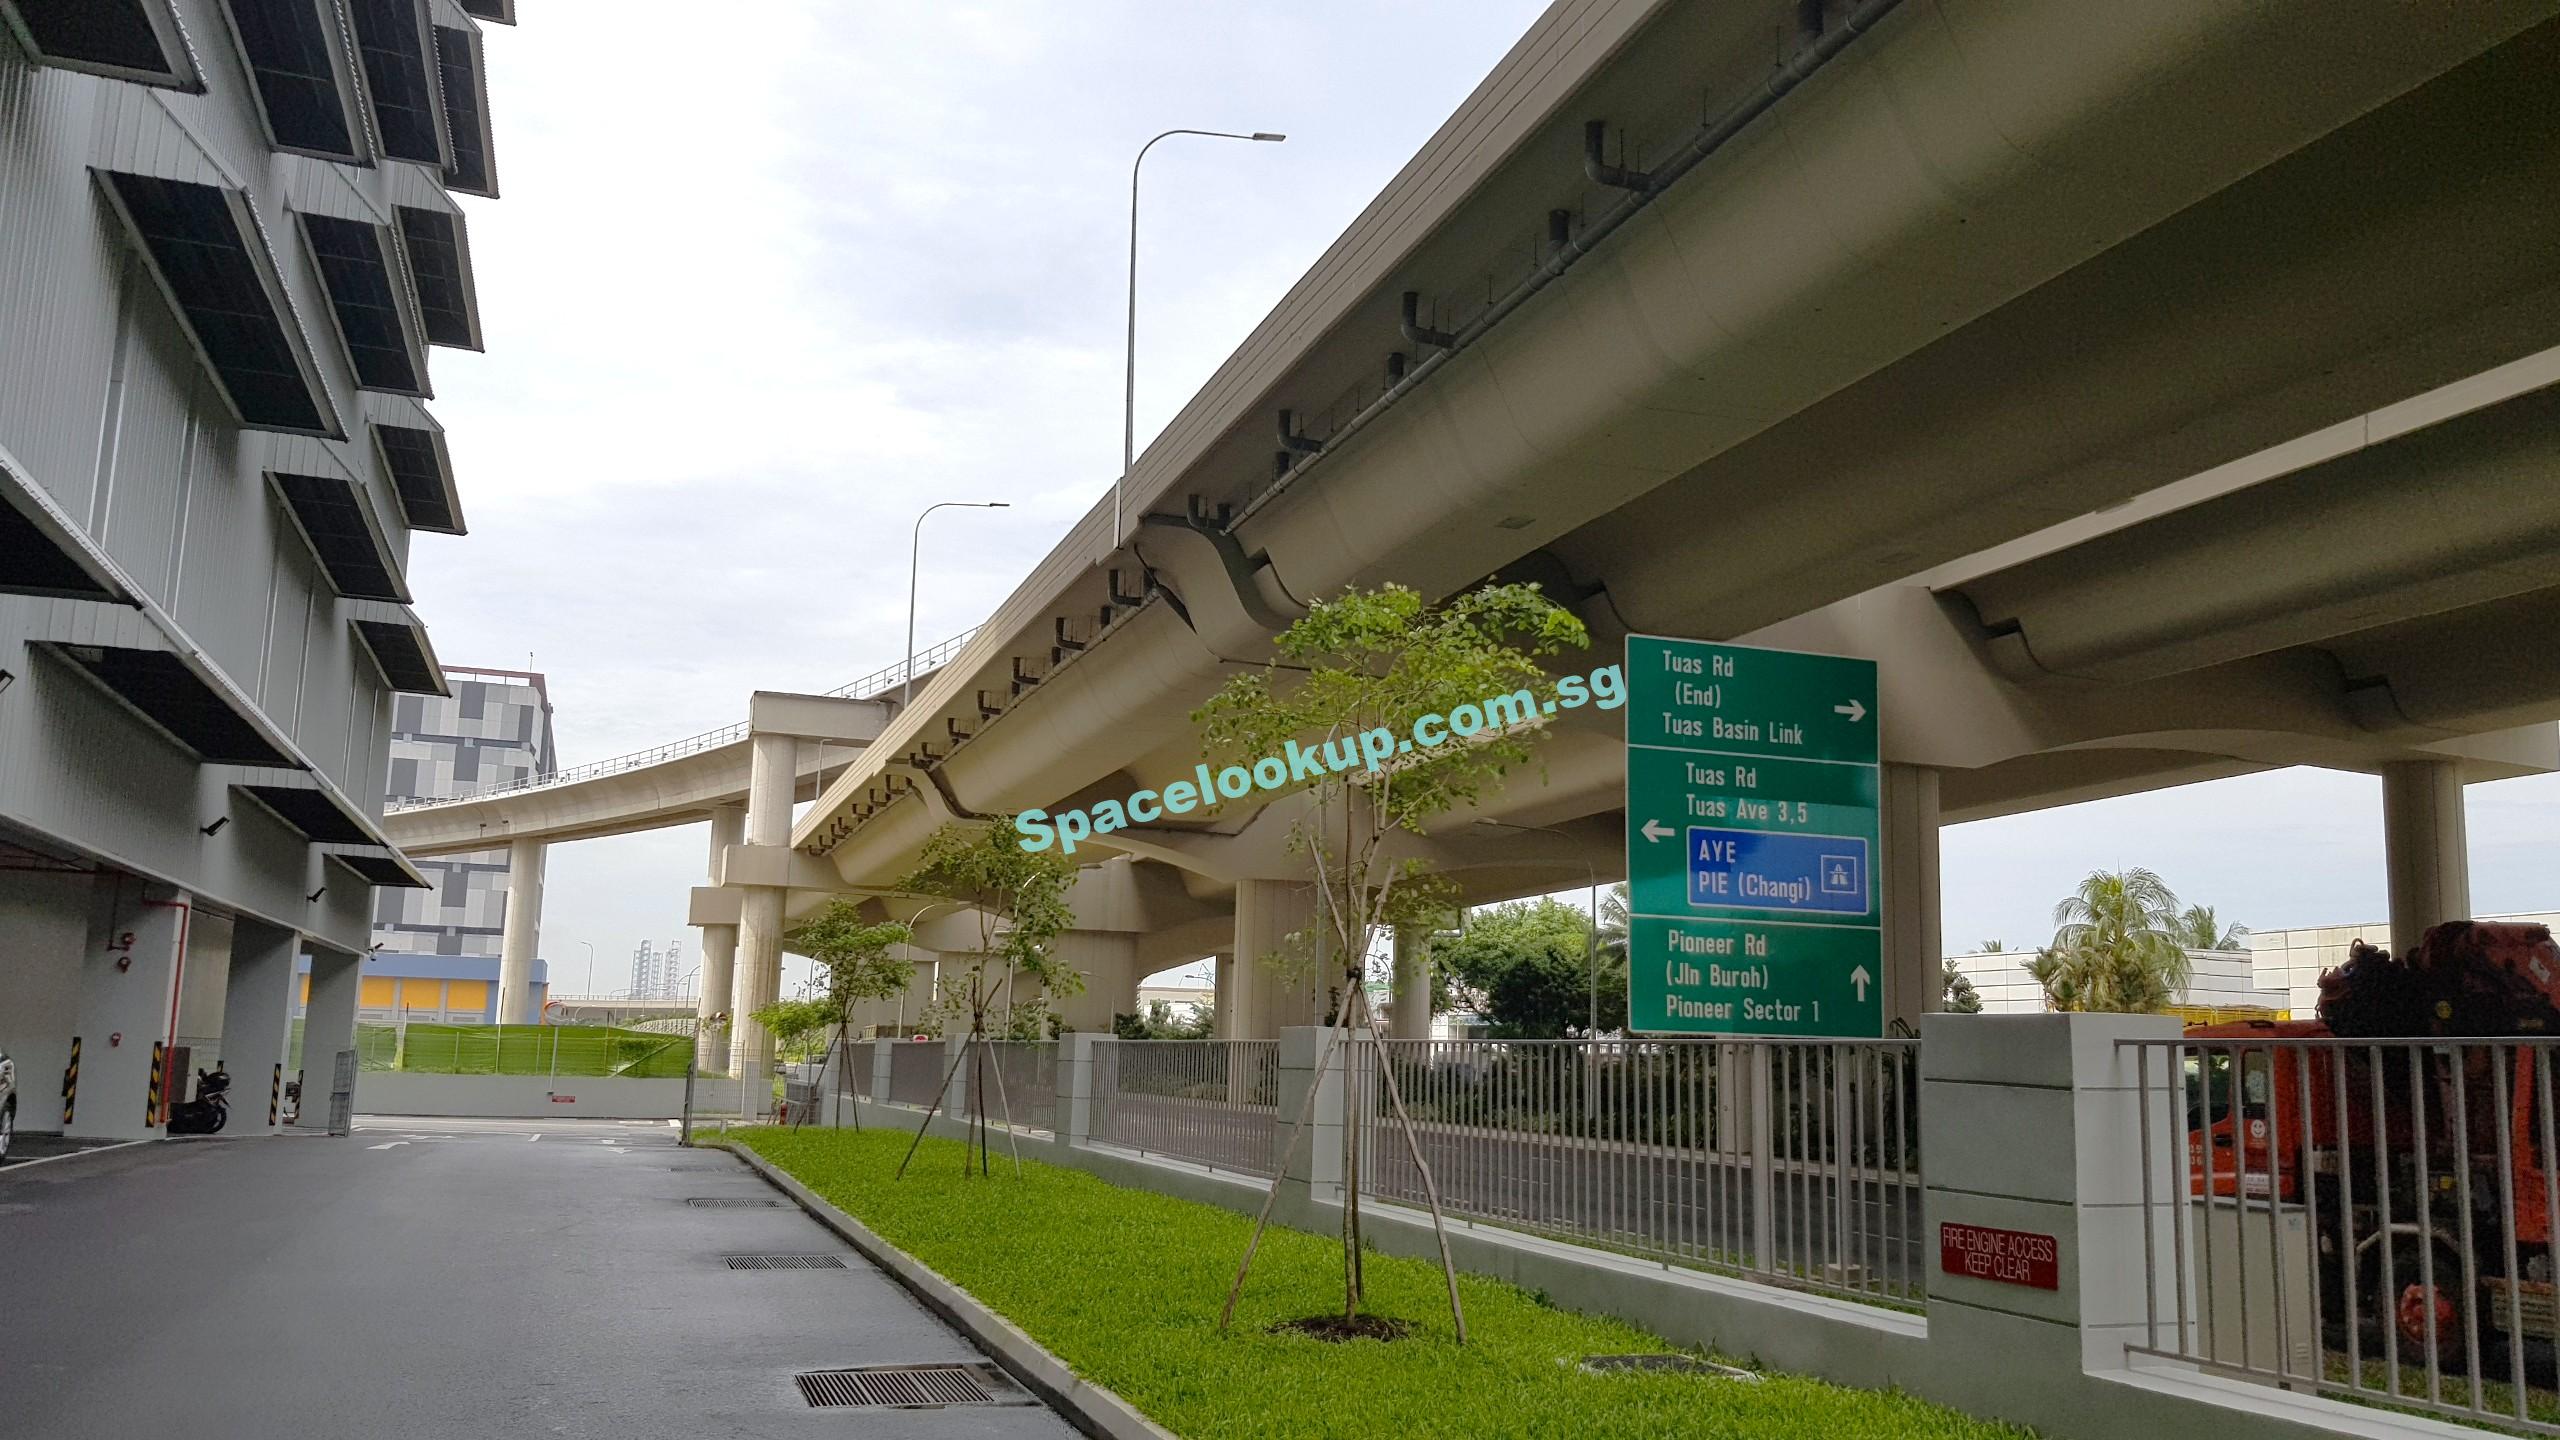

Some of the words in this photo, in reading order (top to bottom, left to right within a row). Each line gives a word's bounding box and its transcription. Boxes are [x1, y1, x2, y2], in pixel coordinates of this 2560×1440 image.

[1662, 649, 1702, 674] Tuas
[1712, 654, 1734, 677] Rd
[1675, 680, 1721, 709] (End)
[1662, 711, 1702, 736] Tuas
[1712, 716, 1759, 741] Basin
[1769, 721, 1803, 745] Link
[1686, 762, 1725, 786] Tuas
[1735, 765, 1757, 789] Rd
[1686, 793, 1726, 817] Tuas
[1736, 798, 1768, 820] Ave
[1778, 800, 1808, 824] 3,5
[1698, 839, 1736, 863] AYE
[1699, 870, 1728, 894] PIE
[1738, 871, 1811, 903] (Changi)
[1668, 929, 1734, 955] Pioneer
[1744, 933, 1767, 957] Rd
[1666, 960, 1701, 986] (Jln
[1709, 963, 1769, 990] Buroh)
[1666, 994, 1732, 1020] Pioneer
[1743, 997, 1802, 1022] Sector
[1811, 1000, 1820, 1022] 1
[1943, 1226, 1965, 1249] FIRE
[1966, 1230, 2006, 1256] ENGINE
[2008, 1236, 2053, 1262] ACCESS
[1964, 1251, 1991, 1275] KEEP
[1993, 1255, 2031, 1281] CLEAR
